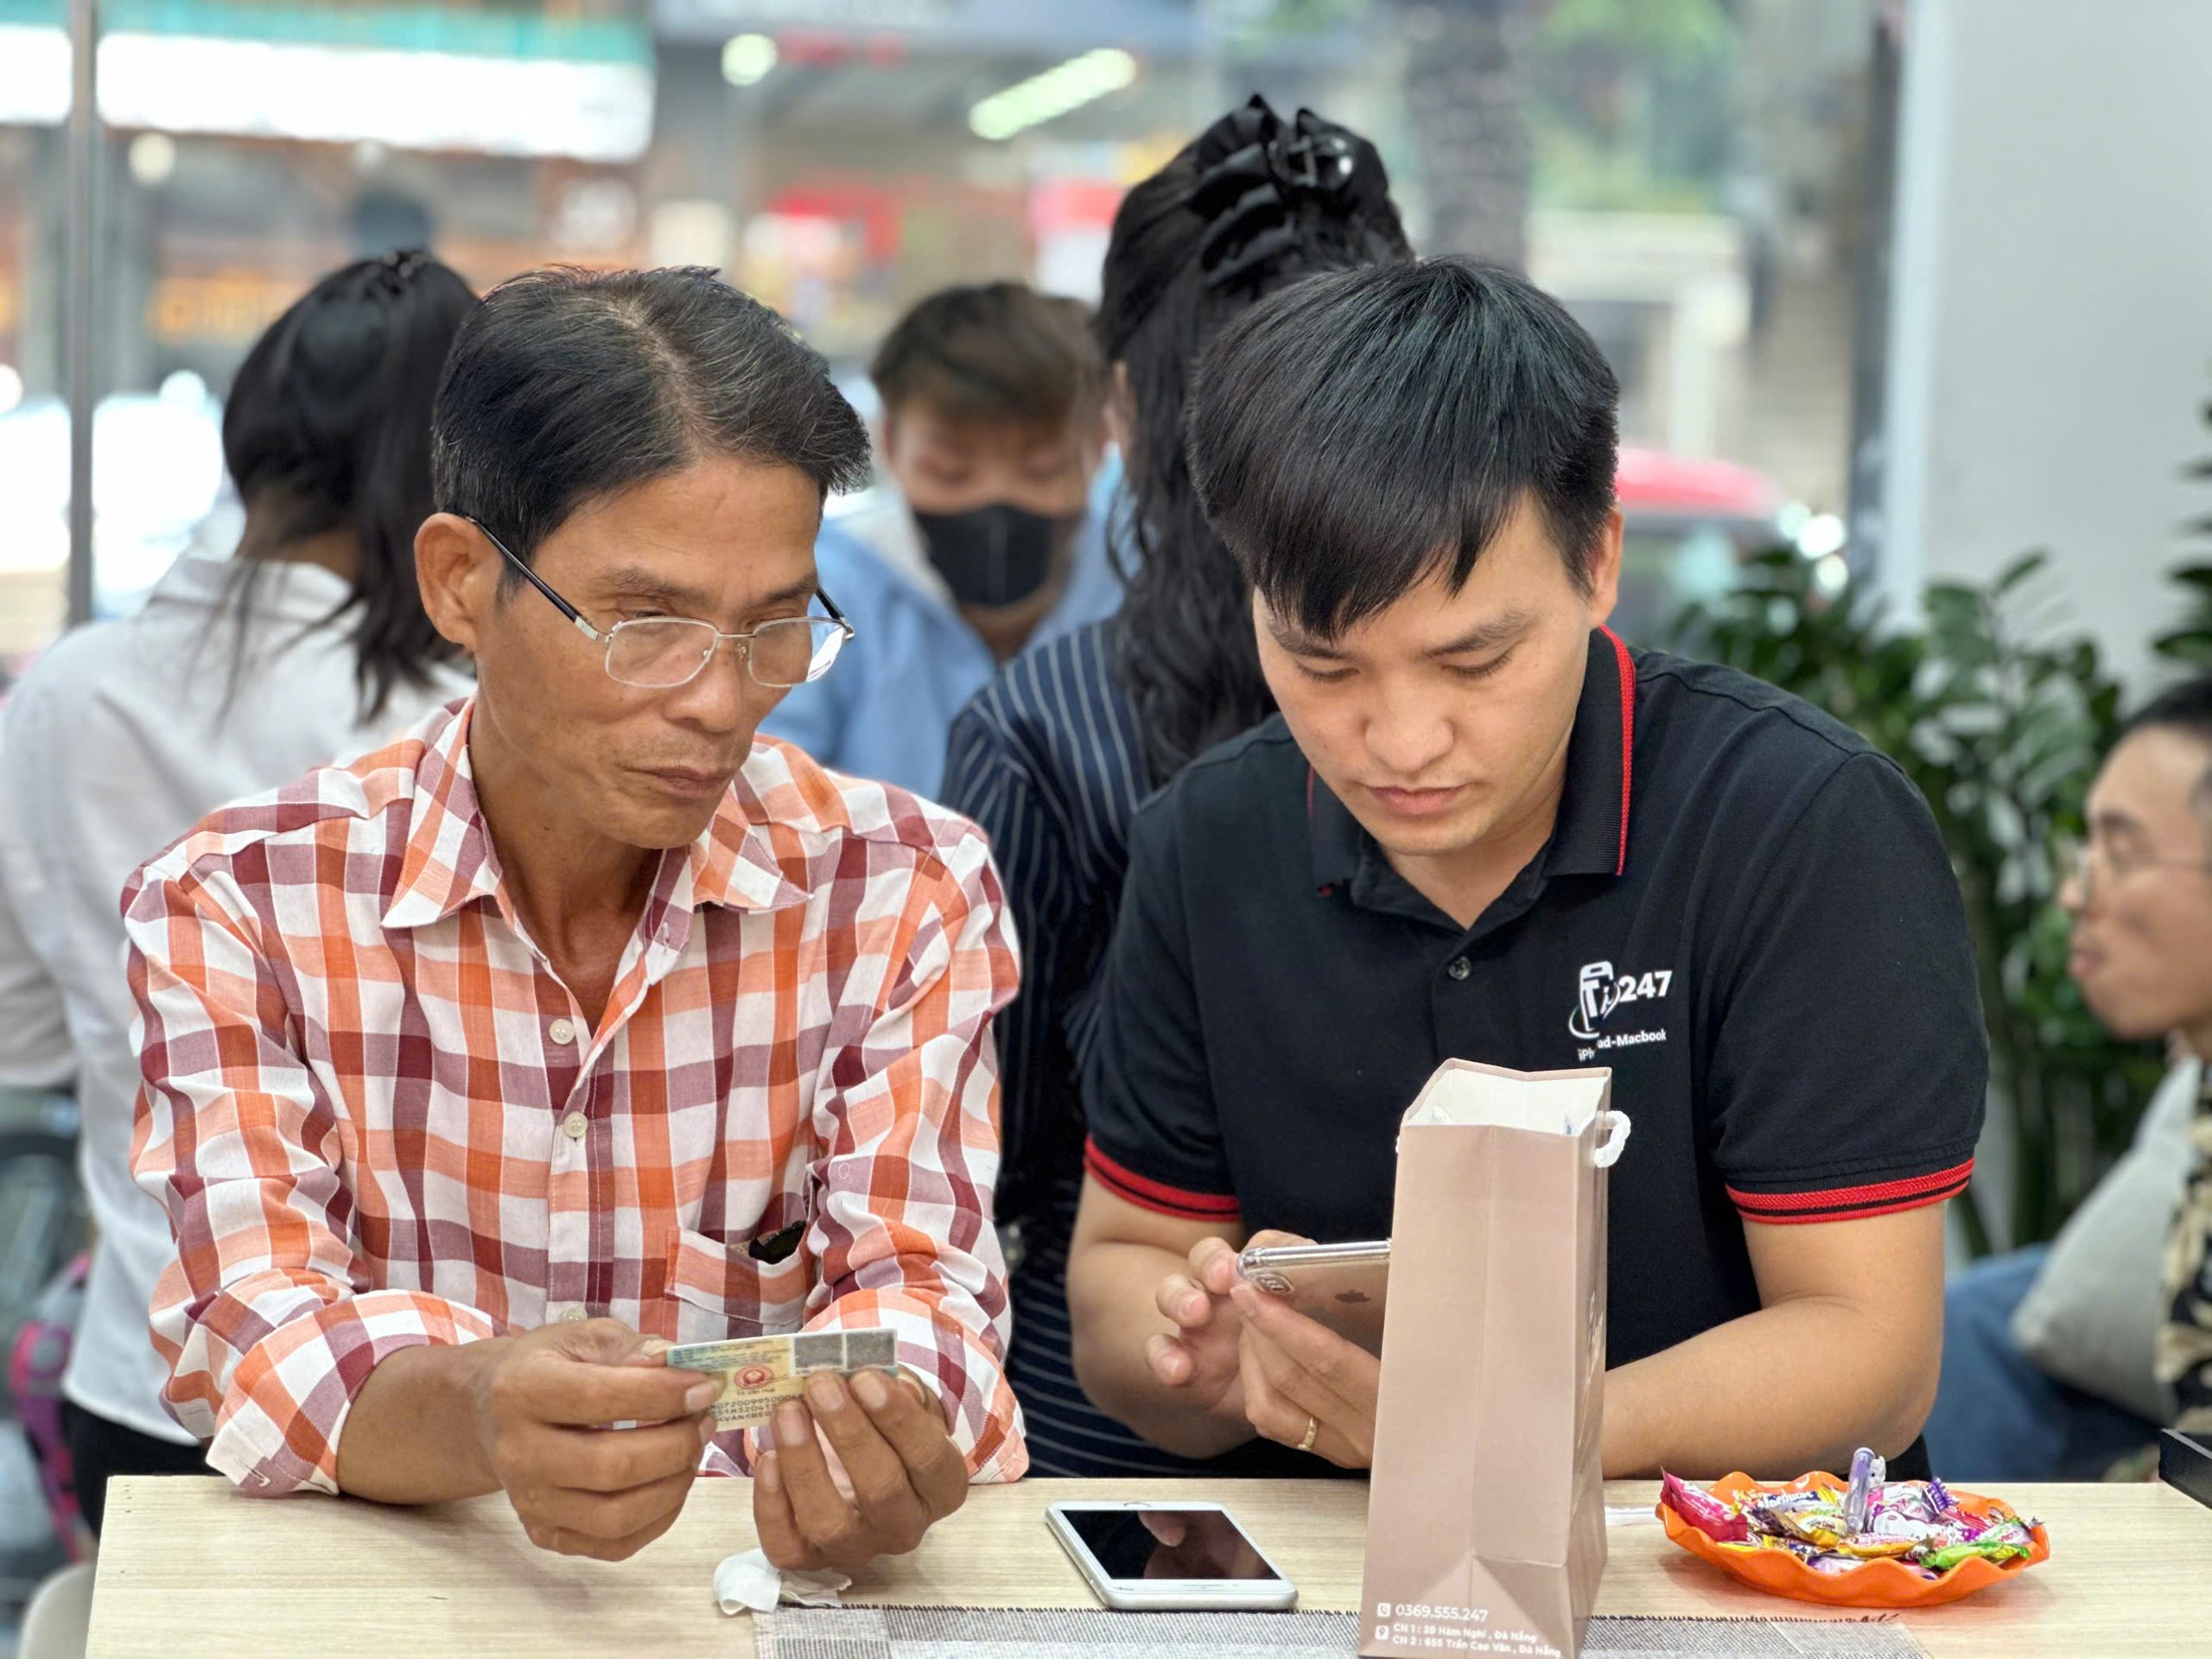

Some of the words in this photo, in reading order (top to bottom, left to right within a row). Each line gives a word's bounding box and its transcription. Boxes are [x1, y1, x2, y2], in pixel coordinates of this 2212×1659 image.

[1618, 969, 1673, 1002] 247
[1597, 1027, 1668, 1049] ad-Macbook
[1395, 1604, 1489, 1622] 0369.555.247
[1393, 1623, 1408, 1633] CN
[1463, 1627, 1486, 1638] Nghi
[1392, 1635, 1408, 1645] CN
[1409, 1636, 1417, 1645] 2
[1470, 1641, 1490, 1650] Cao
